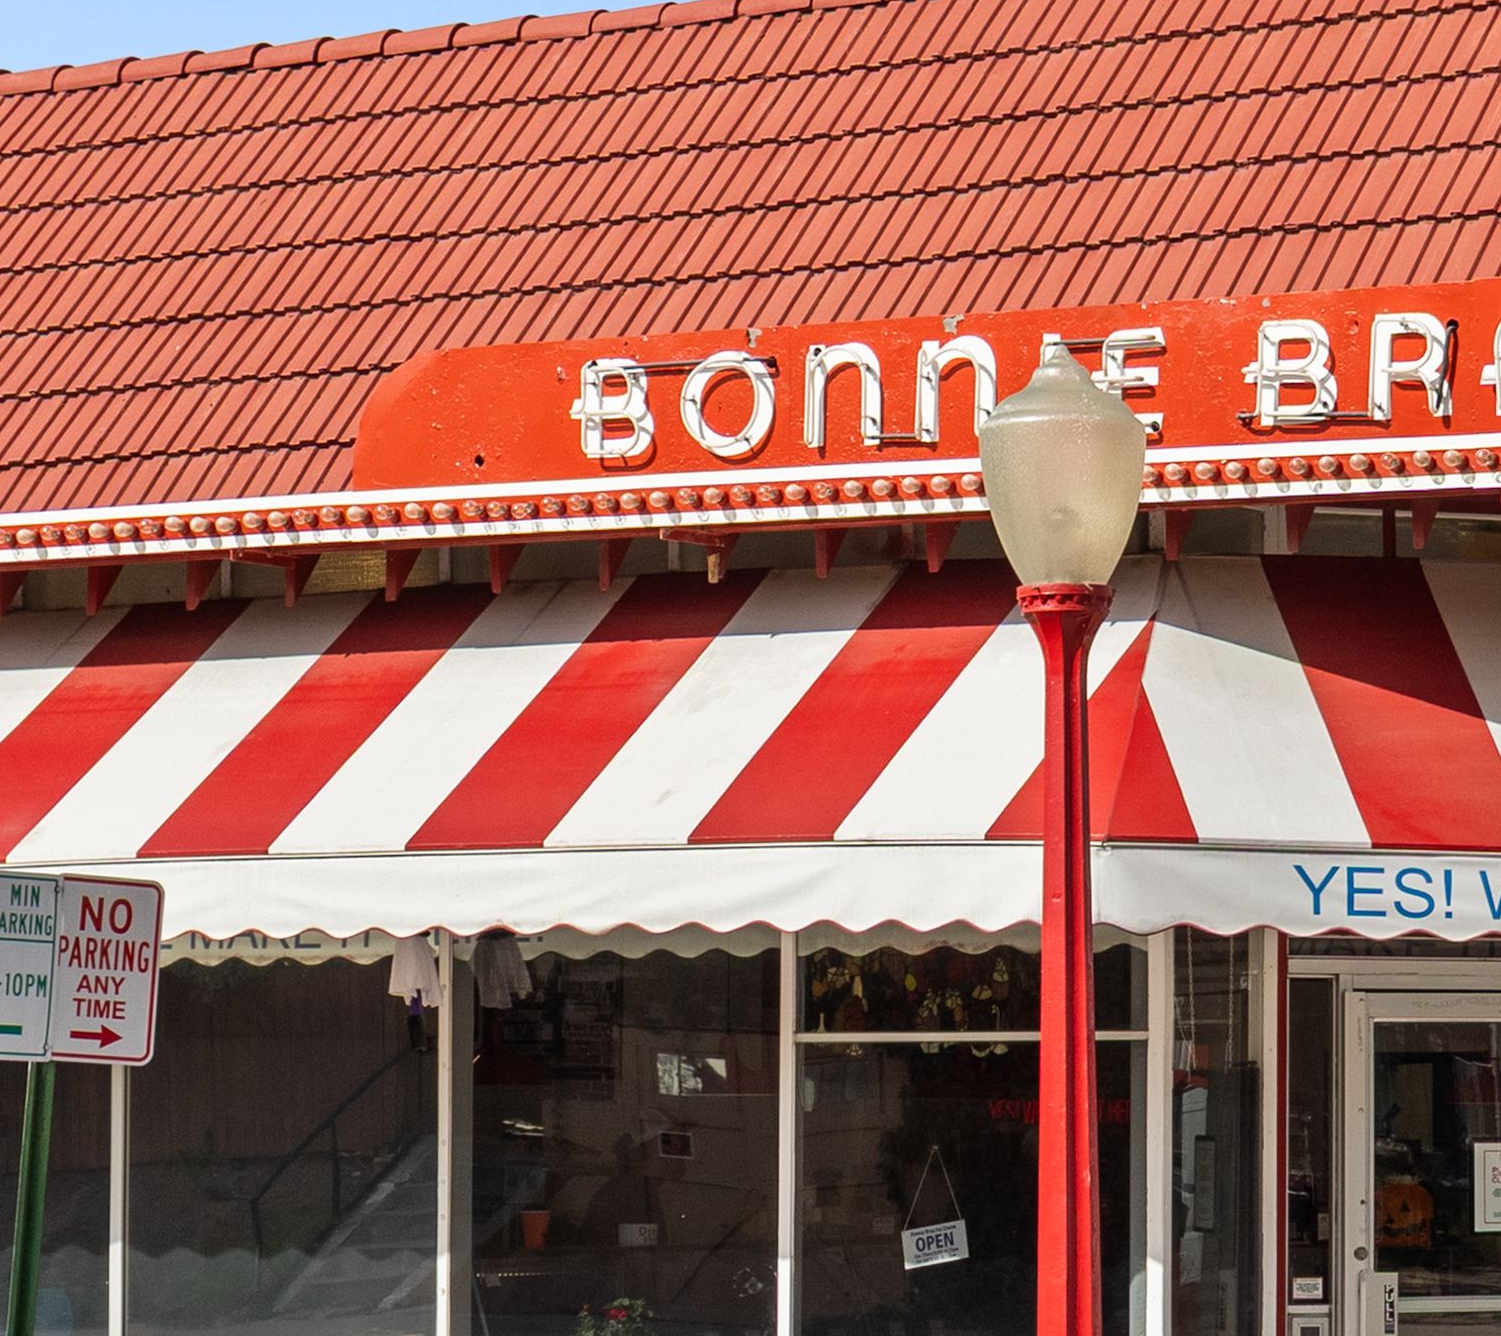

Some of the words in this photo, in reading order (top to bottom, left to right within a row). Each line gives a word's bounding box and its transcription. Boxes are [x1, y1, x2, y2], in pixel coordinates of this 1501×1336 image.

[570, 326, 1165, 459] BONNE
[9, 883, 41, 909] MIN
[1291, 865, 1455, 922] YES!
[78, 895, 134, 935] NO
[58, 935, 150, 974] PARKING
[75, 974, 126, 996] ANY
[72, 997, 127, 1020] TIME
[915, 1231, 955, 1253] OPEN
